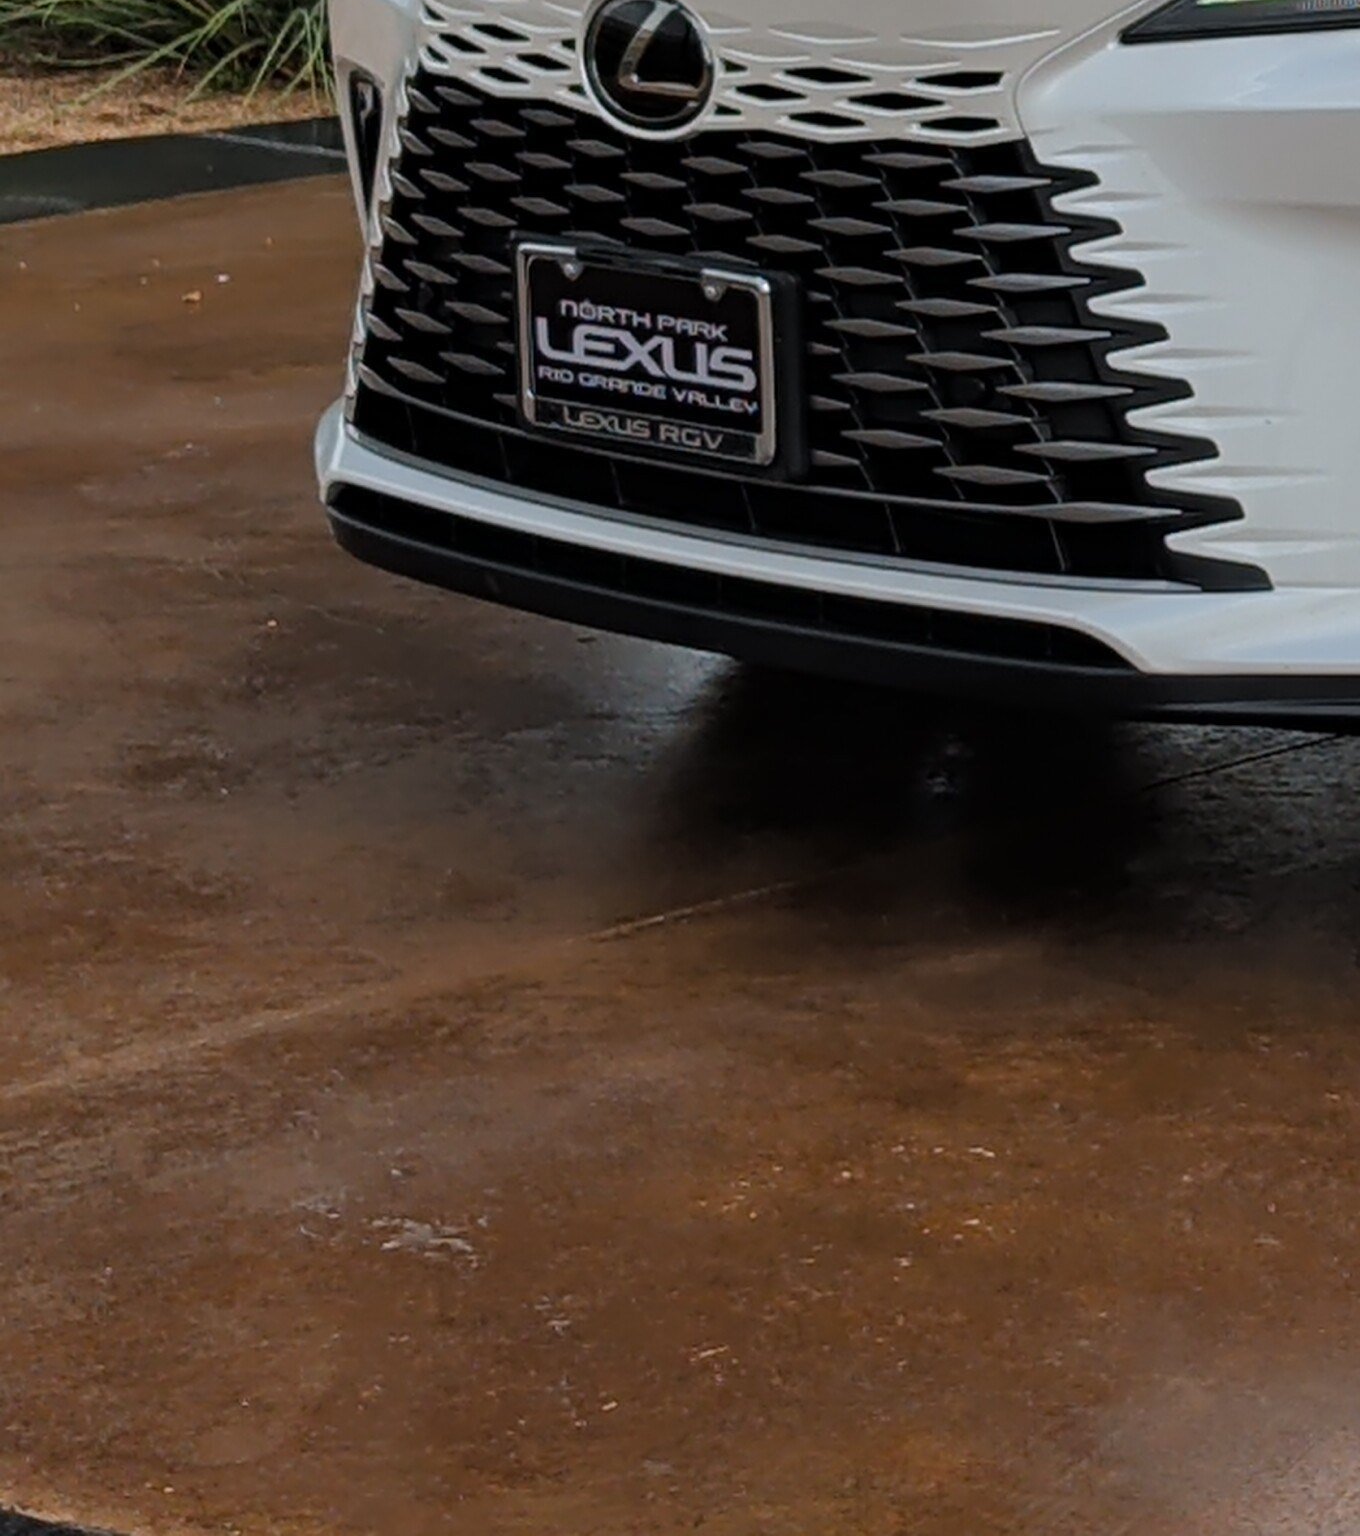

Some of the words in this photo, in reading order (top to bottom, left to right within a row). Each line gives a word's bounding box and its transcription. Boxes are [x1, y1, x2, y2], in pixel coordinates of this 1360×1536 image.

[560, 298, 651, 330] NORTH
[657, 315, 728, 342] PARK
[536, 316, 757, 392] LEXUS
[538, 365, 574, 384] RIO
[578, 373, 667, 400] GRANDE
[672, 386, 759, 414] VALLEY
[563, 406, 650, 438] LEXUS
[659, 423, 723, 449] RGV
